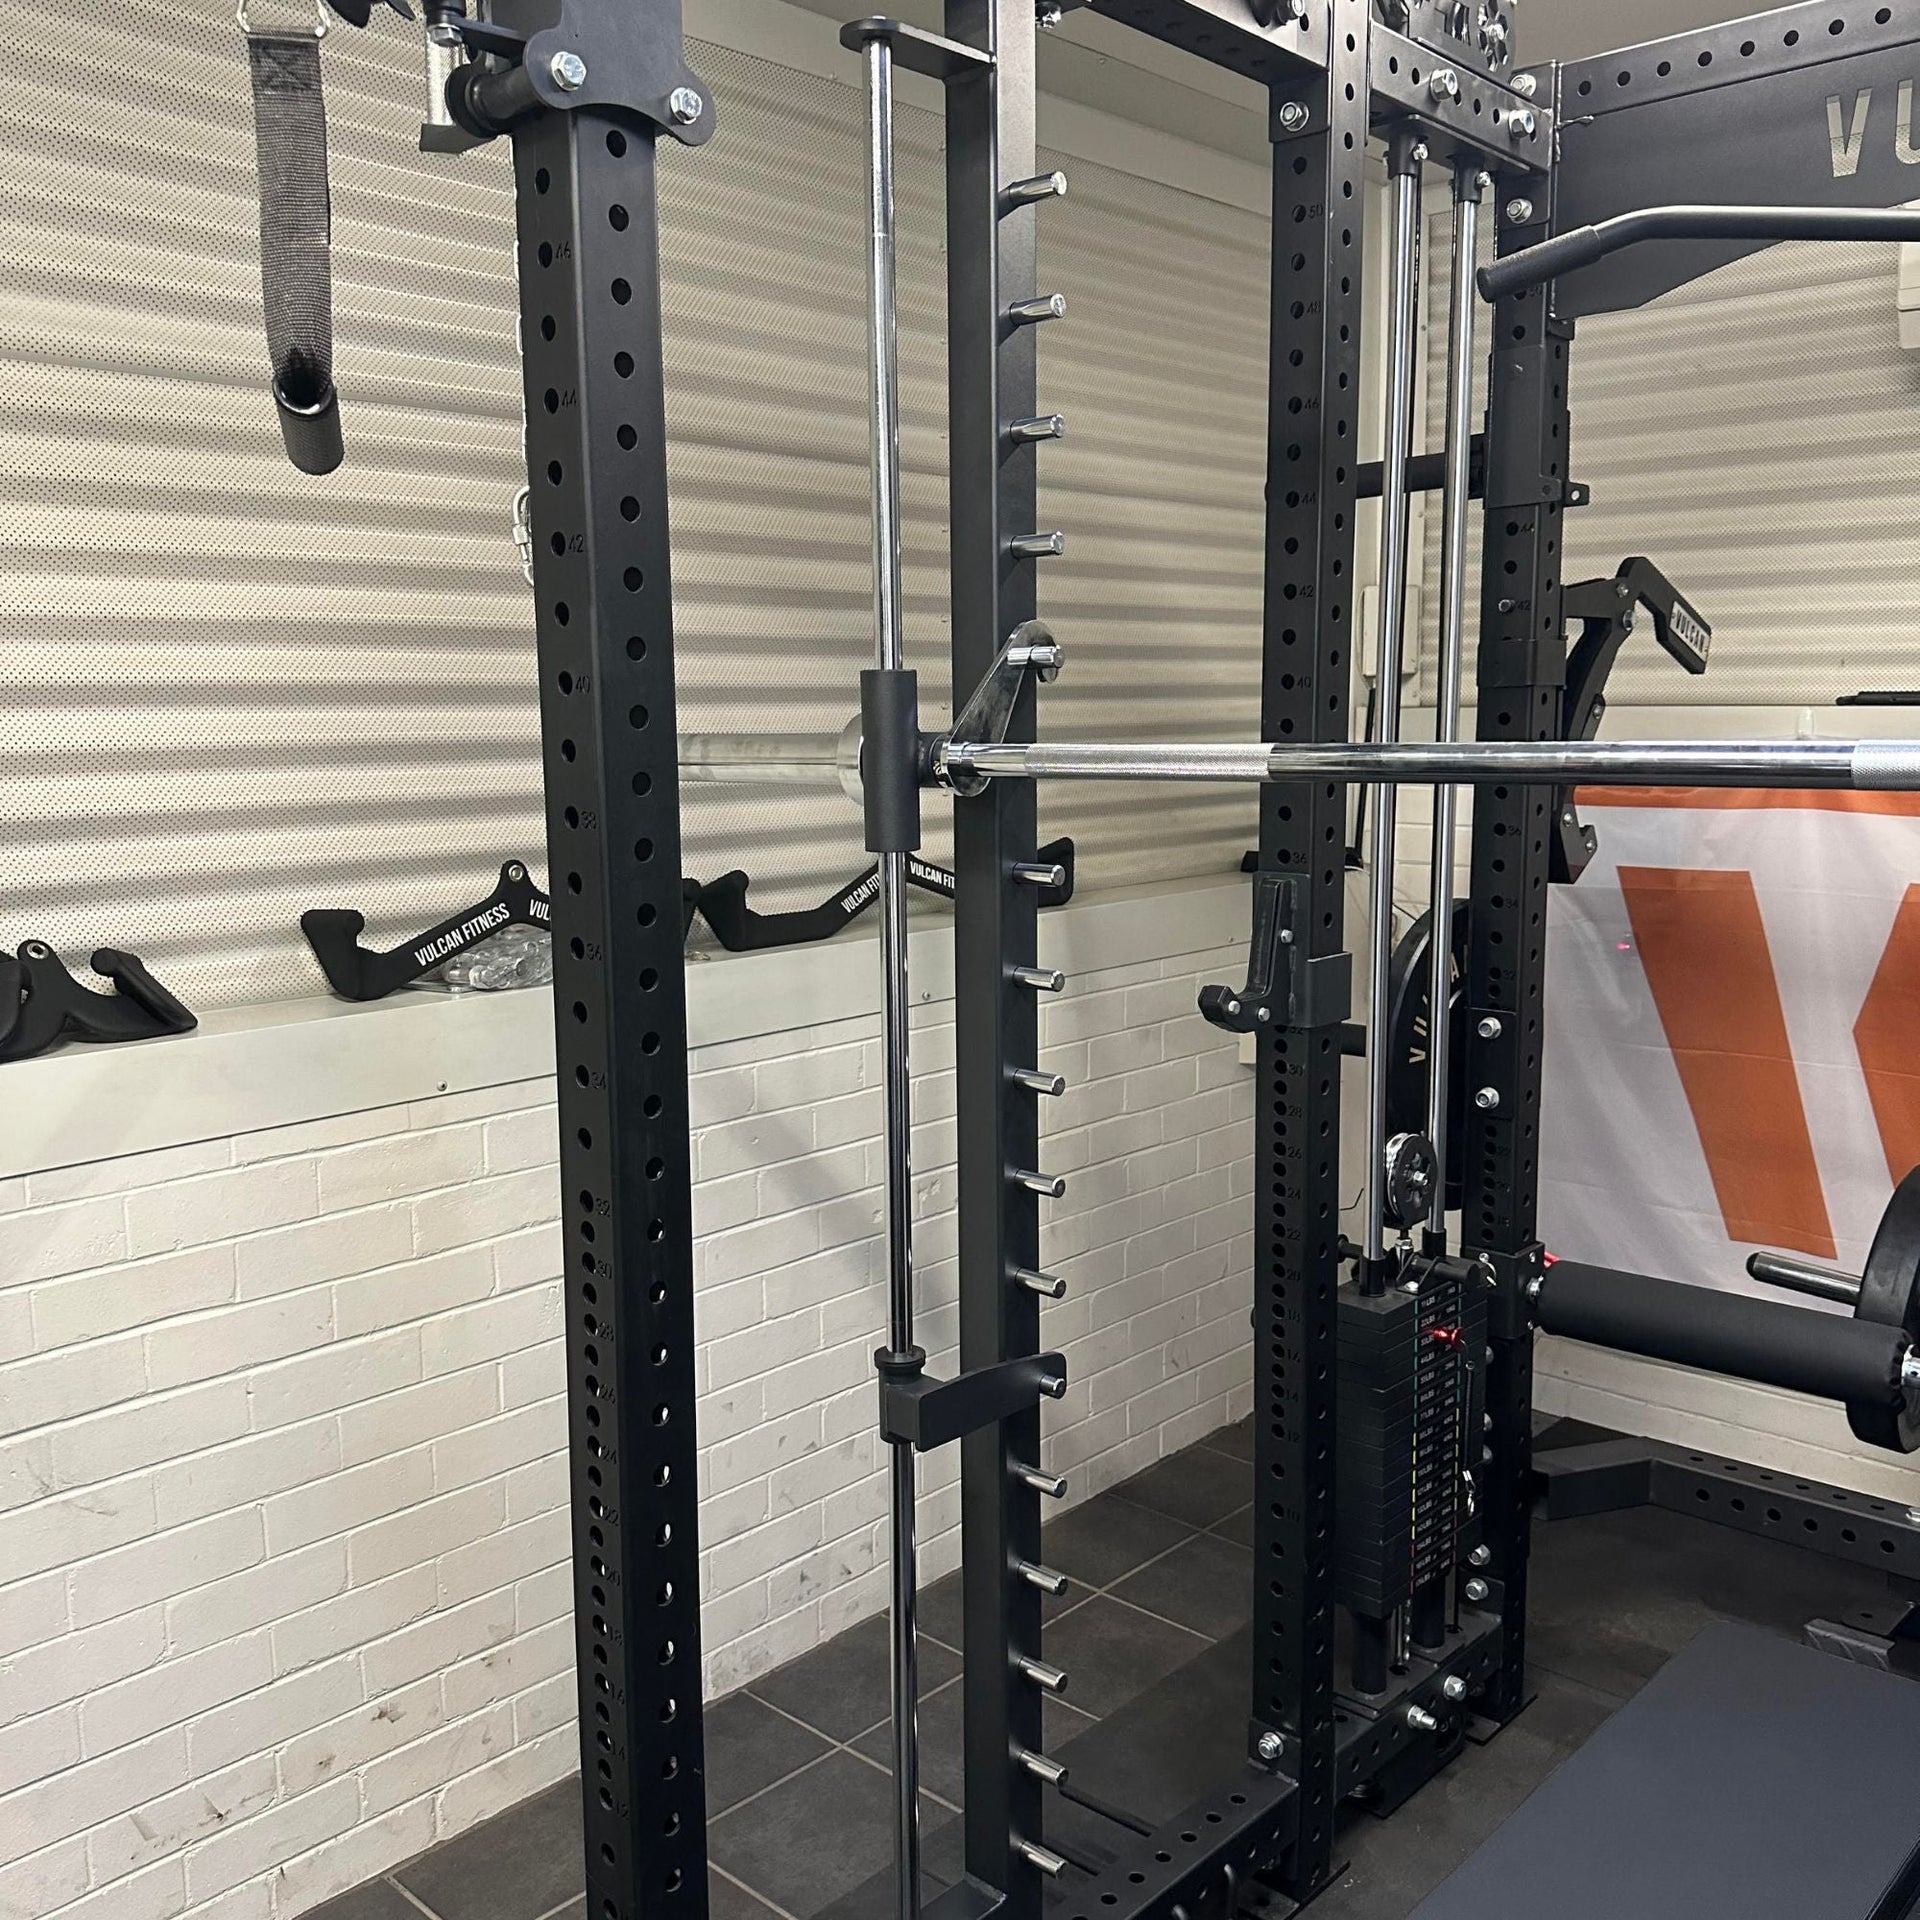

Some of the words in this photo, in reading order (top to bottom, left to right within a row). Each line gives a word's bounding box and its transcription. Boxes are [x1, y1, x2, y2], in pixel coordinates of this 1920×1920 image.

[1309, 204, 1324, 219] 50
[556, 241, 572, 261] 46
[1306, 300, 1322, 315] 48
[561, 389, 577, 406] 44
[1304, 397, 1320, 411] 46
[1301, 491, 1317, 505] 44
[568, 533, 584, 554] 42
[1299, 584, 1315, 598] 42
[1517, 600, 1531, 611] 42
[1675, 609, 1706, 654] VULCAN
[575, 675, 591, 695] 40
[1296, 675, 1312, 689] 40
[1292, 851, 1307, 865] 36
[910, 860, 942, 885] VULCAN
[840, 882, 871, 914] VULCAN
[414, 928, 465, 967] VULCAN
[461, 902, 511, 941] FITNESS
[586, 942, 603, 961] 36
[1289, 1063, 1304, 1077] 30
[1288, 1105, 1303, 1119] 28
[1288, 1146, 1303, 1160] 26
[1287, 1187, 1301, 1201] 24
[595, 1197, 611, 1217] 32
[1288, 1229, 1302, 1242] 22
